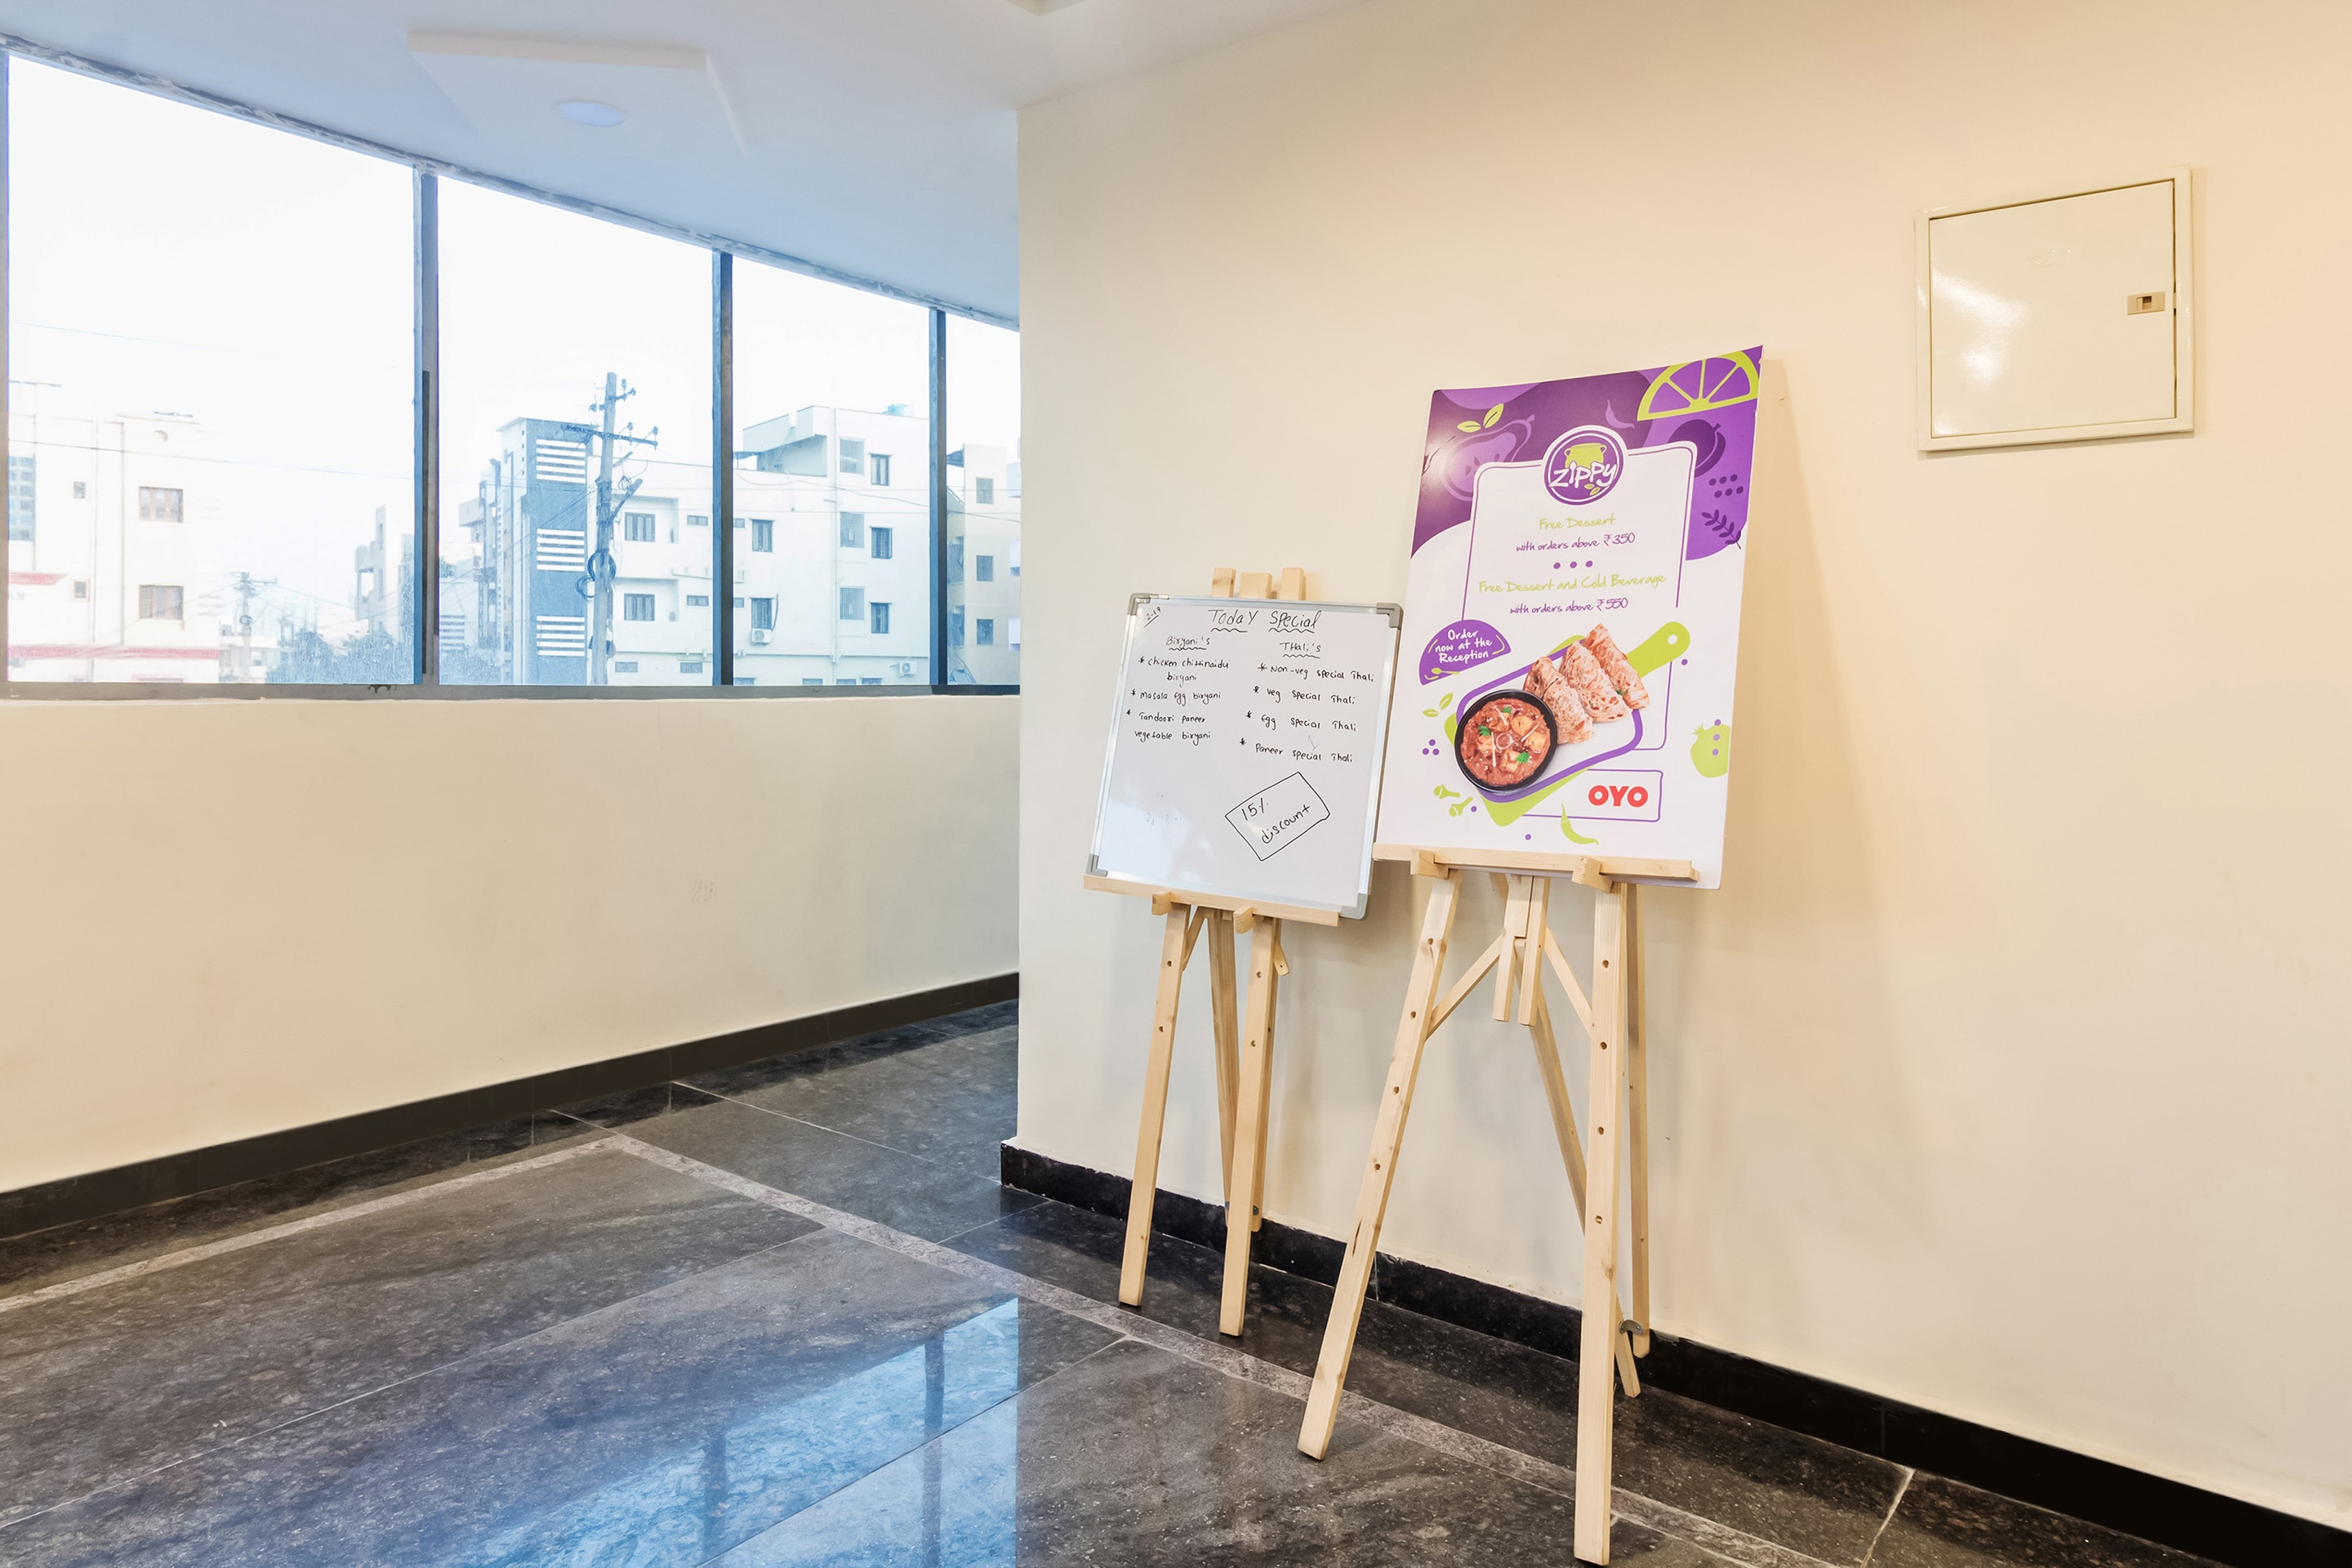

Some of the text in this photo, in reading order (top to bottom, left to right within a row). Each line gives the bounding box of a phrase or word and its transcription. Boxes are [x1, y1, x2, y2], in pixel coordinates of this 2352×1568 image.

[1539, 513, 1617, 530] Free Dessert
[1516, 541, 1535, 552] with
[1537, 540, 1569, 551] orders
[1571, 537, 1600, 549] above
[1479, 573, 1667, 593] Free Dessert and Cold Beverage
[1510, 603, 1529, 614] with
[1531, 603, 1563, 613] orders
[1565, 599, 1594, 612] above
[1447, 628, 1479, 641] Order
[1435, 636, 1493, 653] now at the
[1438, 649, 1489, 665] Reception
[1588, 785, 1649, 808] OYO
[1261, 804, 1311, 844] discount
